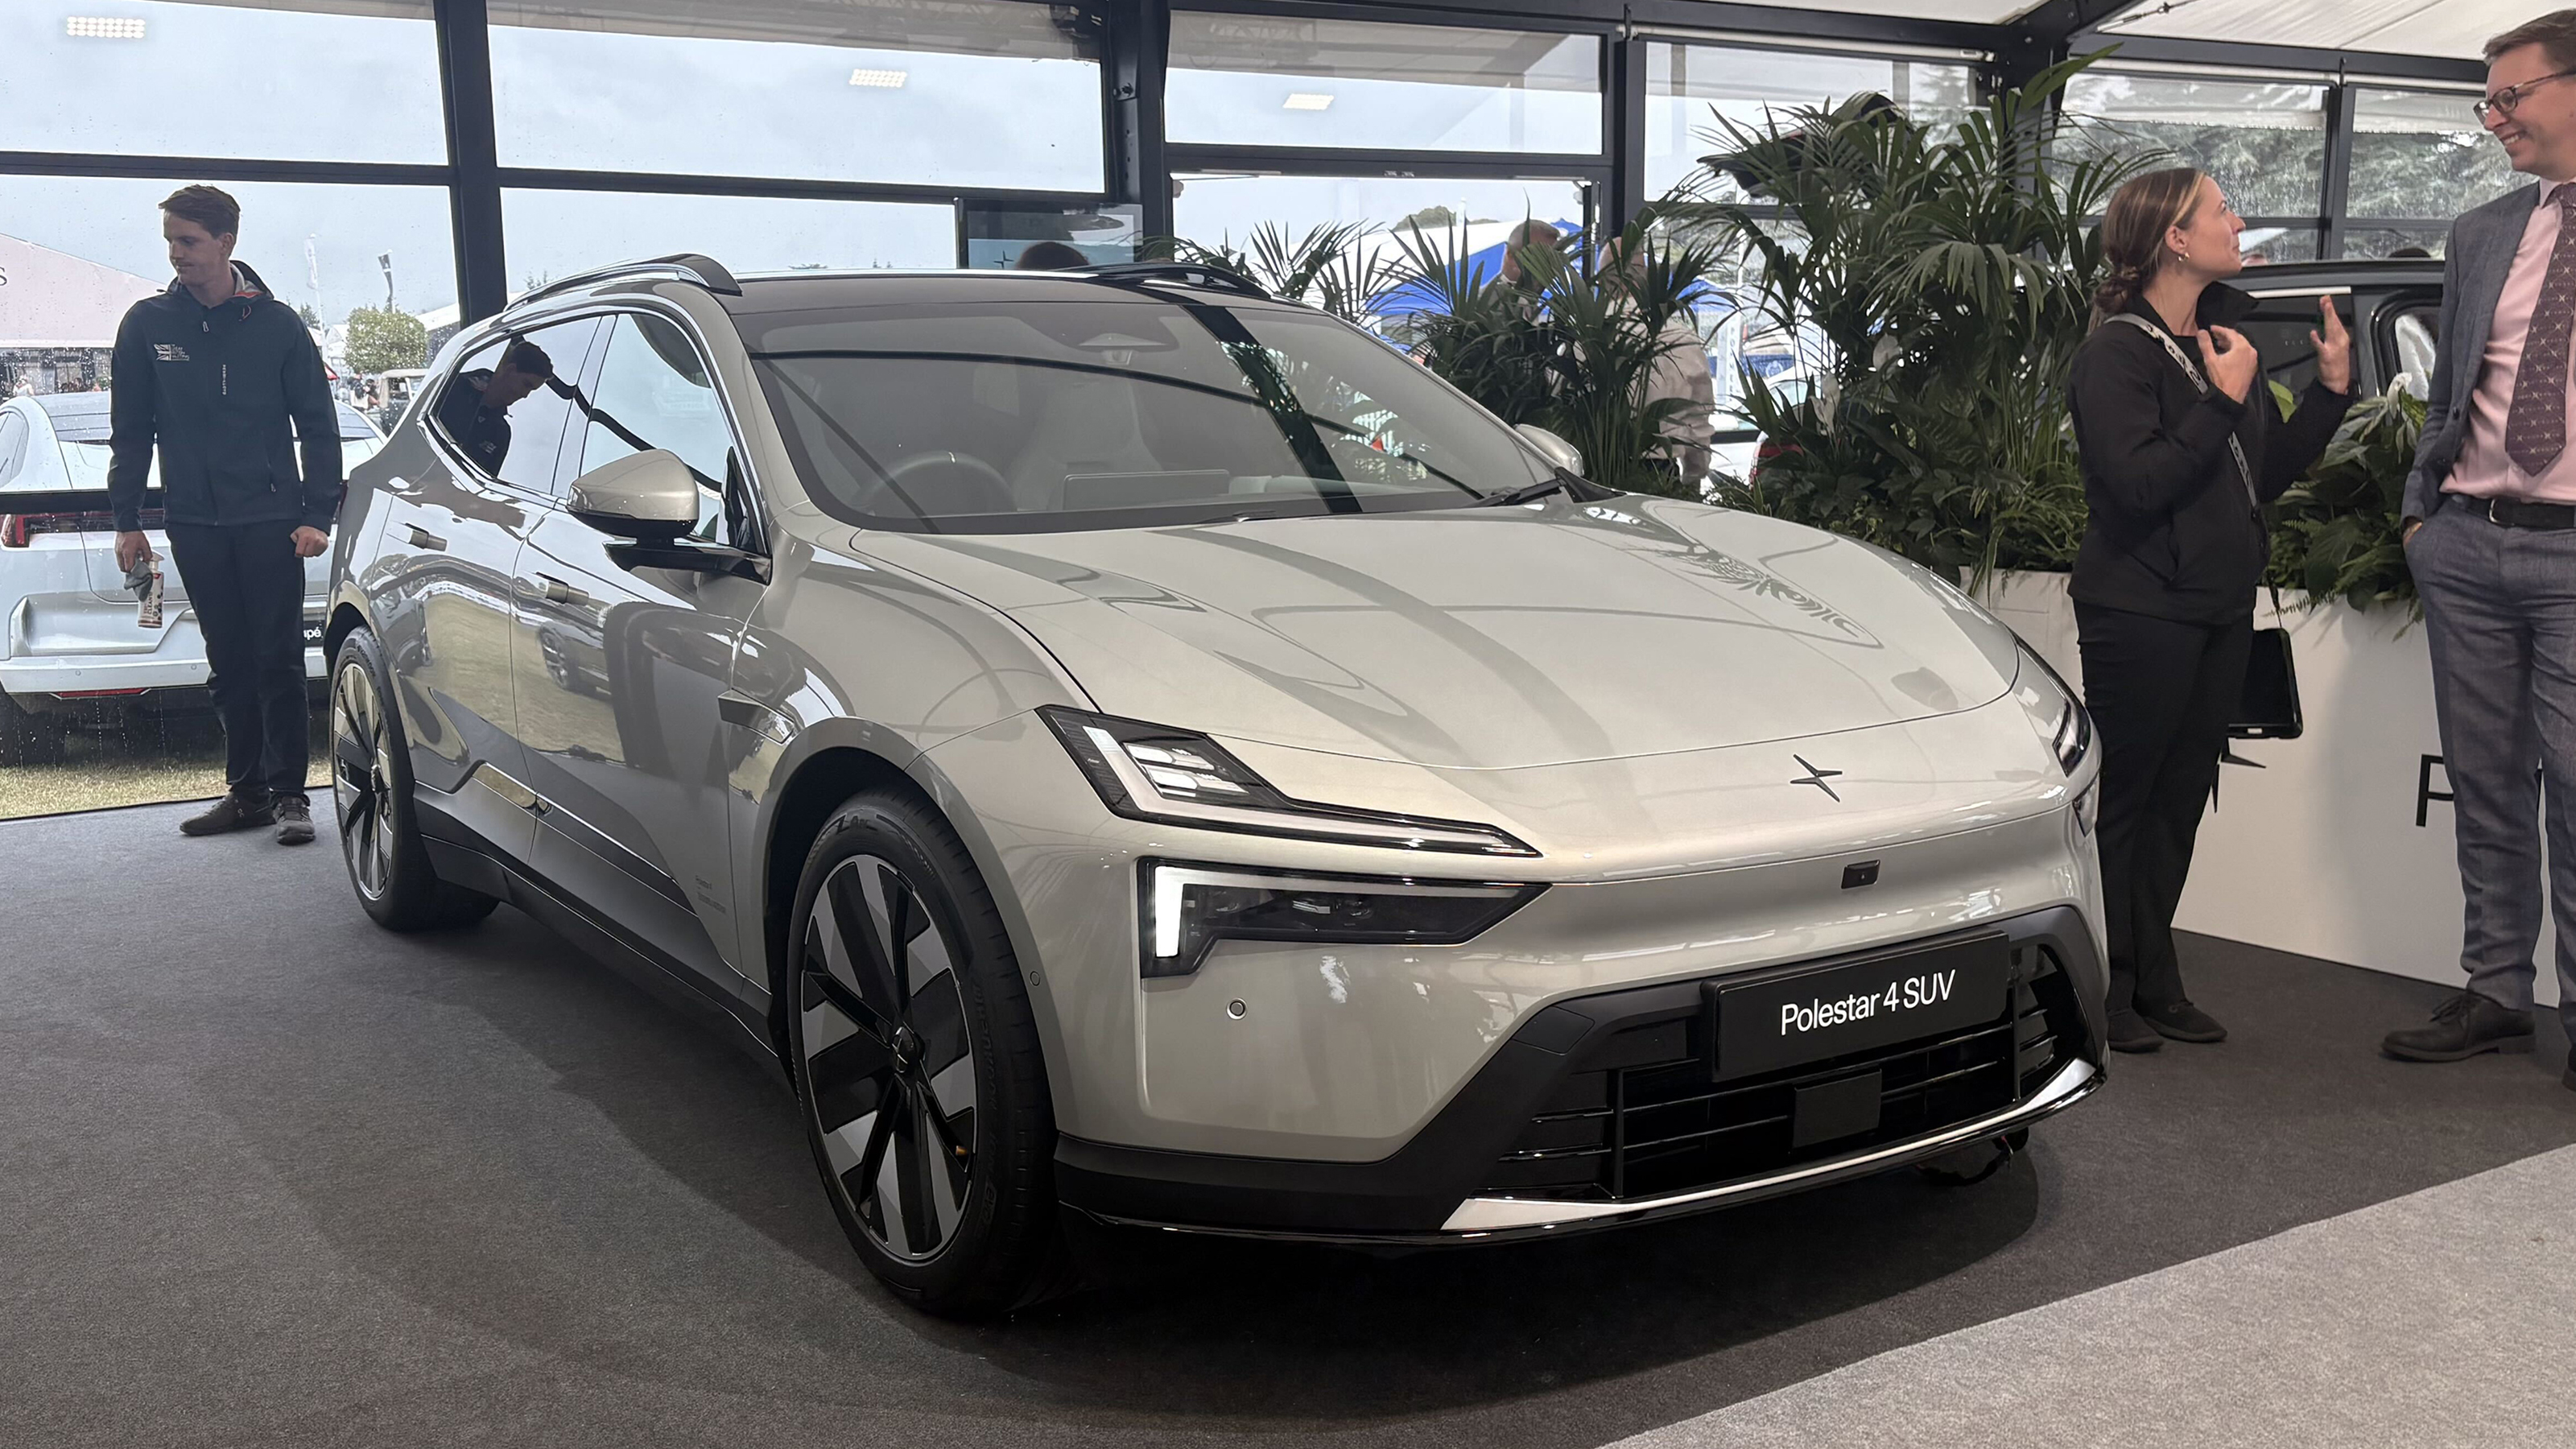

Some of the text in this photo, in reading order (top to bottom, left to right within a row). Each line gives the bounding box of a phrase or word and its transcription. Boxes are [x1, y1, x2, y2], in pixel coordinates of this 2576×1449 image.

[1781, 969, 1957, 1036] Polestar 4 SUV
